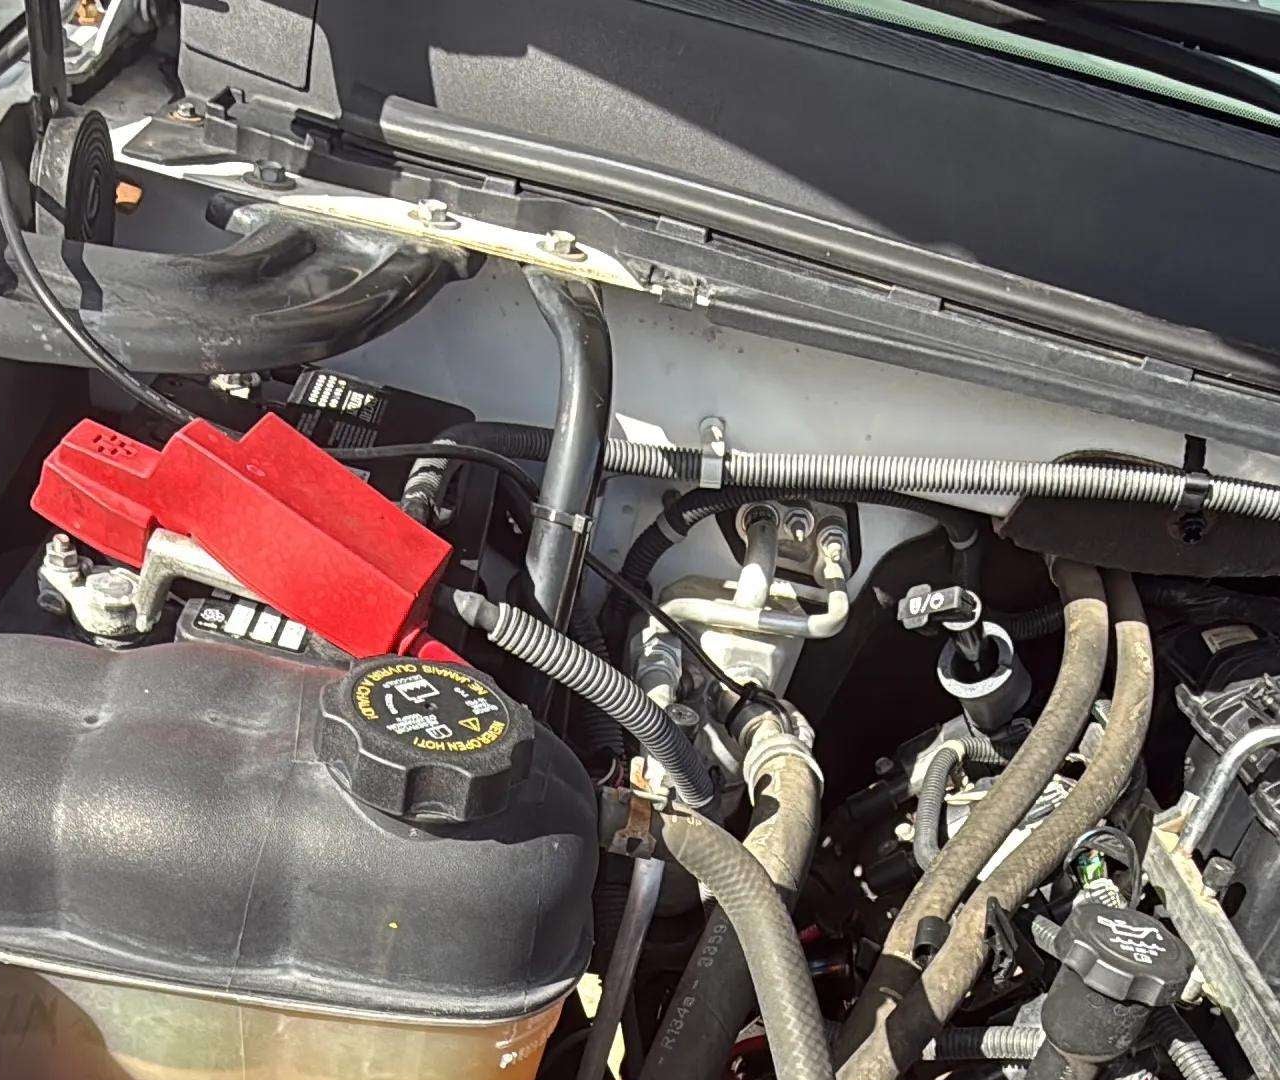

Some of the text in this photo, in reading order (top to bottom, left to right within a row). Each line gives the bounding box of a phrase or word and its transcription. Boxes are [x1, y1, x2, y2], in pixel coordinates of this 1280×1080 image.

[370, 664, 417, 682] OUVRIR
[422, 665, 470, 686] JAMAIS
[447, 740, 482, 751] OPEN
[661, 996, 695, 1051] R134a
